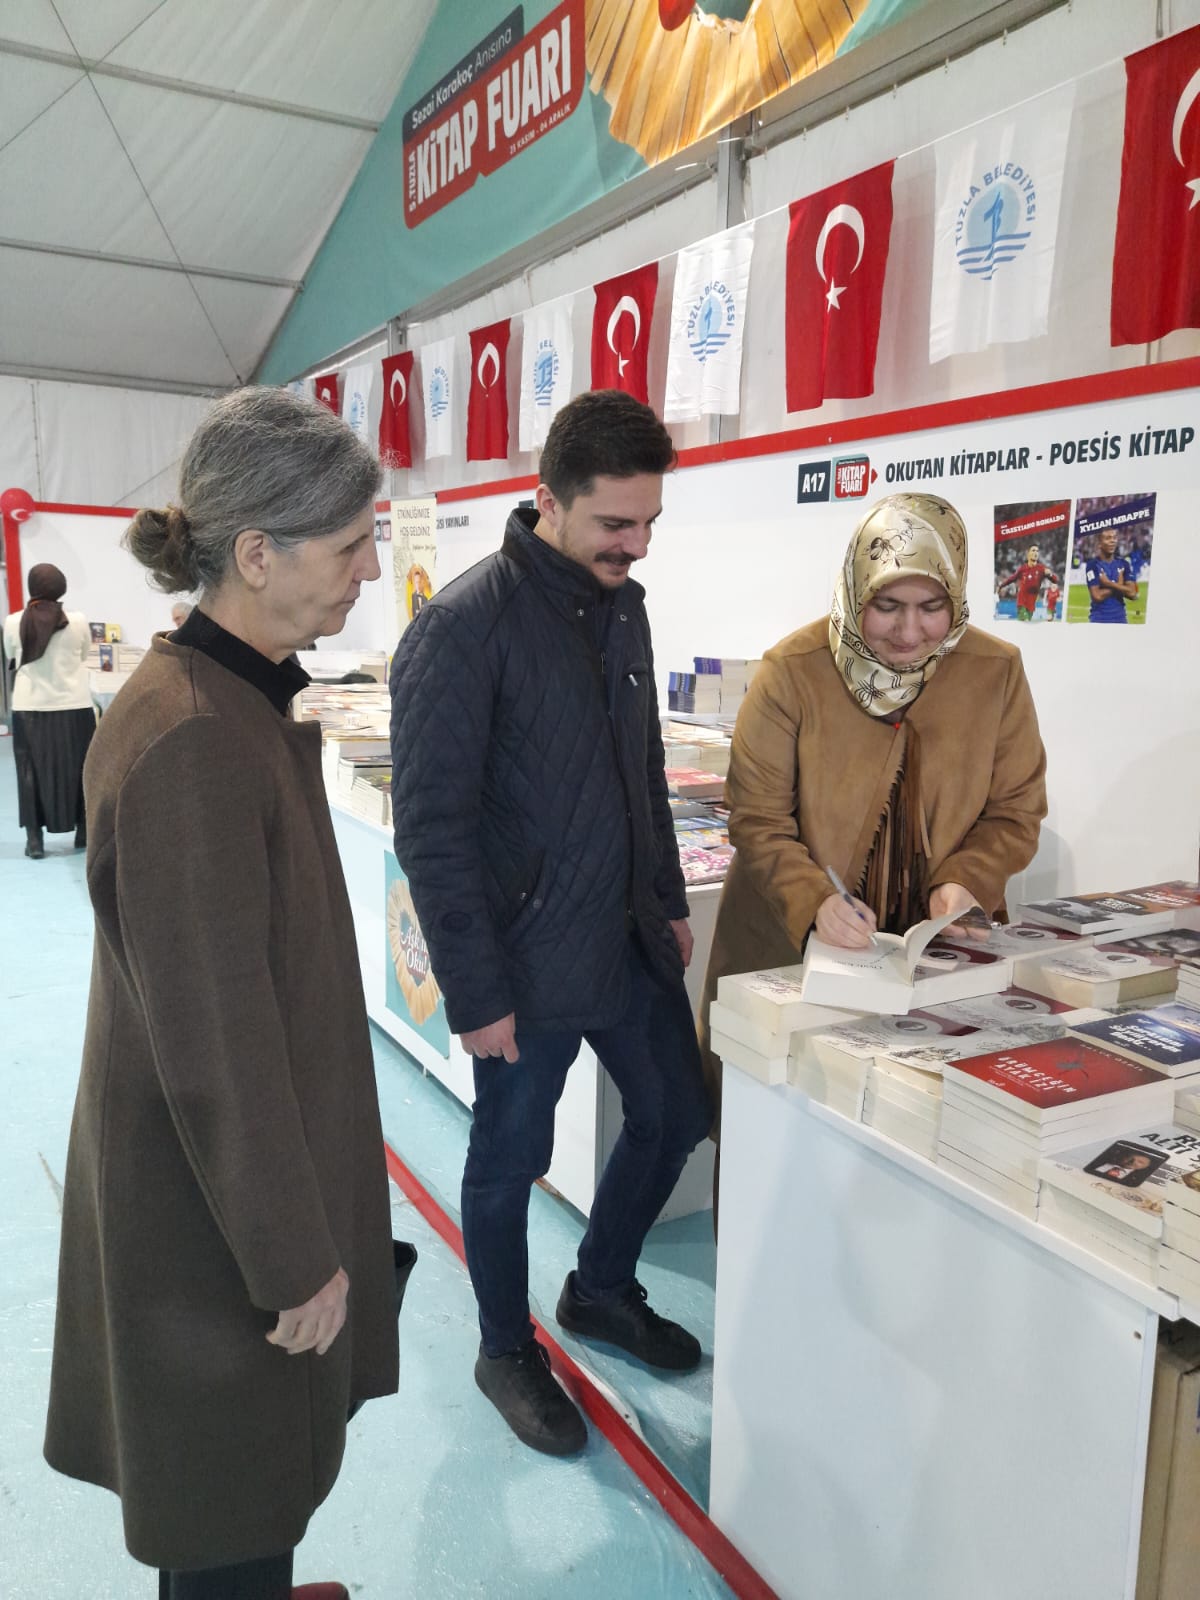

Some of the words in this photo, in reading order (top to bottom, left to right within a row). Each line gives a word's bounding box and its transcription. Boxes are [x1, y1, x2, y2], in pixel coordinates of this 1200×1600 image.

[411, 95, 435, 129] Sezai
[436, 64, 473, 109] Karakoç
[474, 28, 512, 73] Anısına
[417, 99, 479, 205] KİTAP
[486, 15, 572, 152] FUARI
[408, 151, 416, 200] TUZLA
[955, 185, 981, 247] TUZLA
[885, 457, 945, 483] OKUTAN
[950, 449, 1030, 476] KİTAPLAR
[1049, 431, 1121, 466] POESİS
[1128, 425, 1195, 458] KİTAP
[801, 472, 826, 493] A17
[841, 465, 866, 481] KİTAP
[840, 479, 863, 494] FUARI
[1036, 514, 1065, 527] RONALDO
[1079, 518, 1112, 533] KYLIAN
[1112, 509, 1150, 525] MBAPPE
[406, 947, 427, 975] Oku!
[994, 1063, 1032, 1080] AYAK
[1139, 1133, 1192, 1154] ALTI
